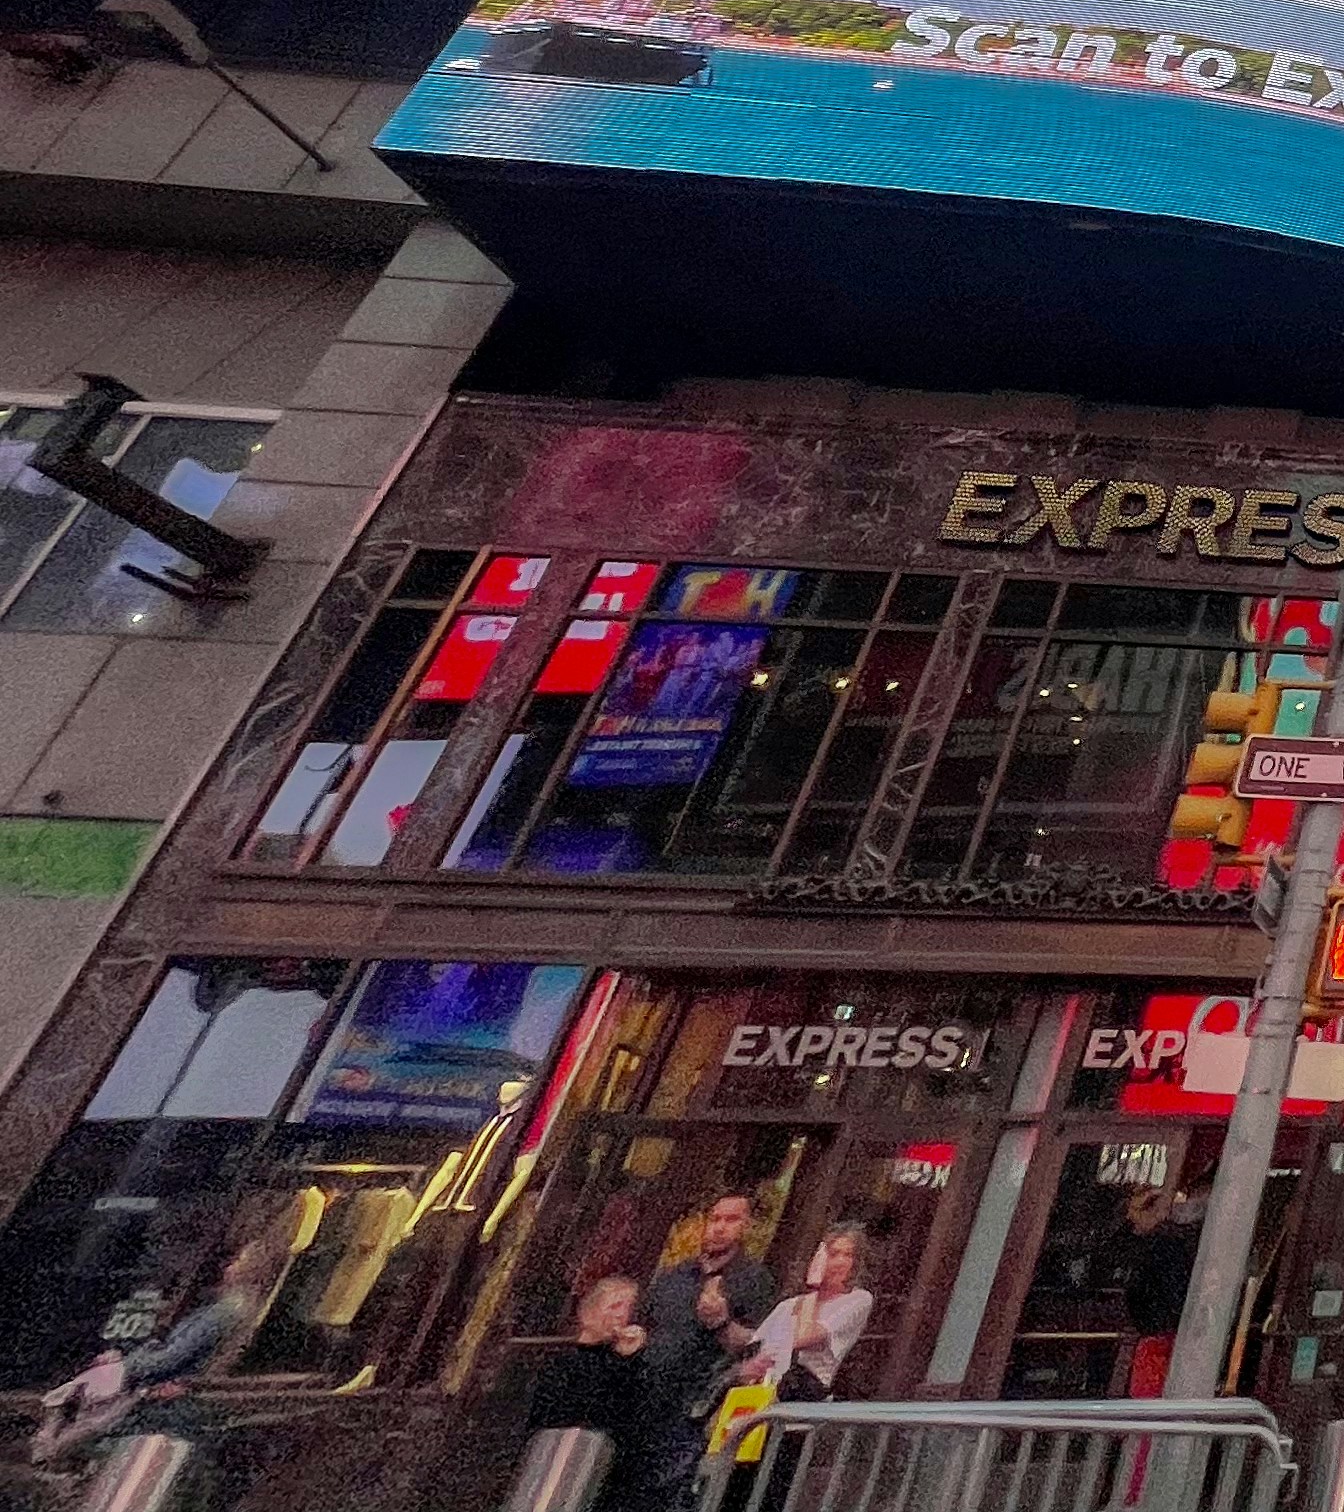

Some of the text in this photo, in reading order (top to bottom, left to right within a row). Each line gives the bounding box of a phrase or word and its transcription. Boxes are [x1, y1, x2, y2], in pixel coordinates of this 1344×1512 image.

[893, 7, 1114, 79] Scan
[1141, 33, 1237, 91] to
[1258, 753, 1308, 779] ONE
[723, 1025, 962, 1070] EXPRESS
